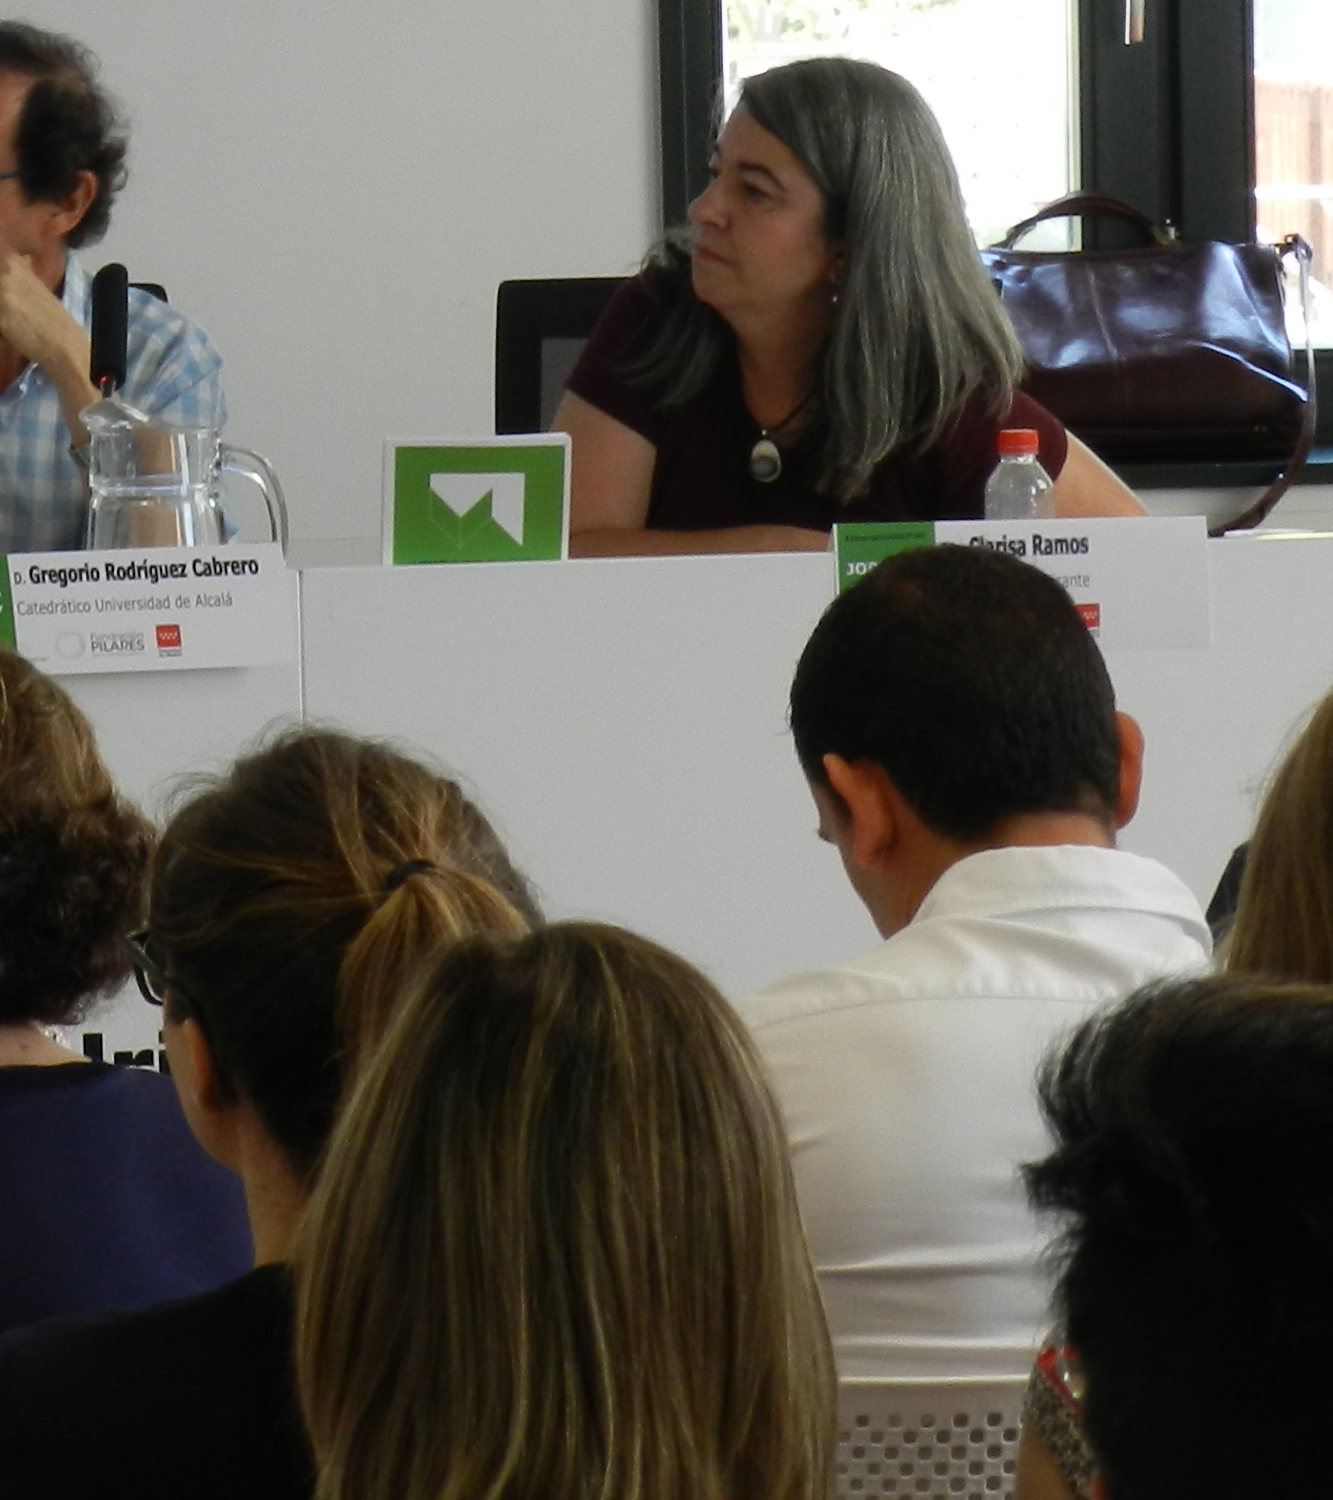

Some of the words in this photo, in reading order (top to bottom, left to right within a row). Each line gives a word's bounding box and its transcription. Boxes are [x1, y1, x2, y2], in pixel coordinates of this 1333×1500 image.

[1032, 534, 1089, 556] Ramos
[14, 571, 26, 586] D.
[29, 563, 101, 589] Gregorio
[104, 560, 187, 588] Rodríguez
[191, 555, 259, 578] Cabrero
[16, 596, 91, 617] Catedrático
[95, 595, 171, 613] Universidad
[175, 594, 191, 610] de
[194, 590, 233, 609] Alcalá
[90, 639, 145, 653] PILARES
